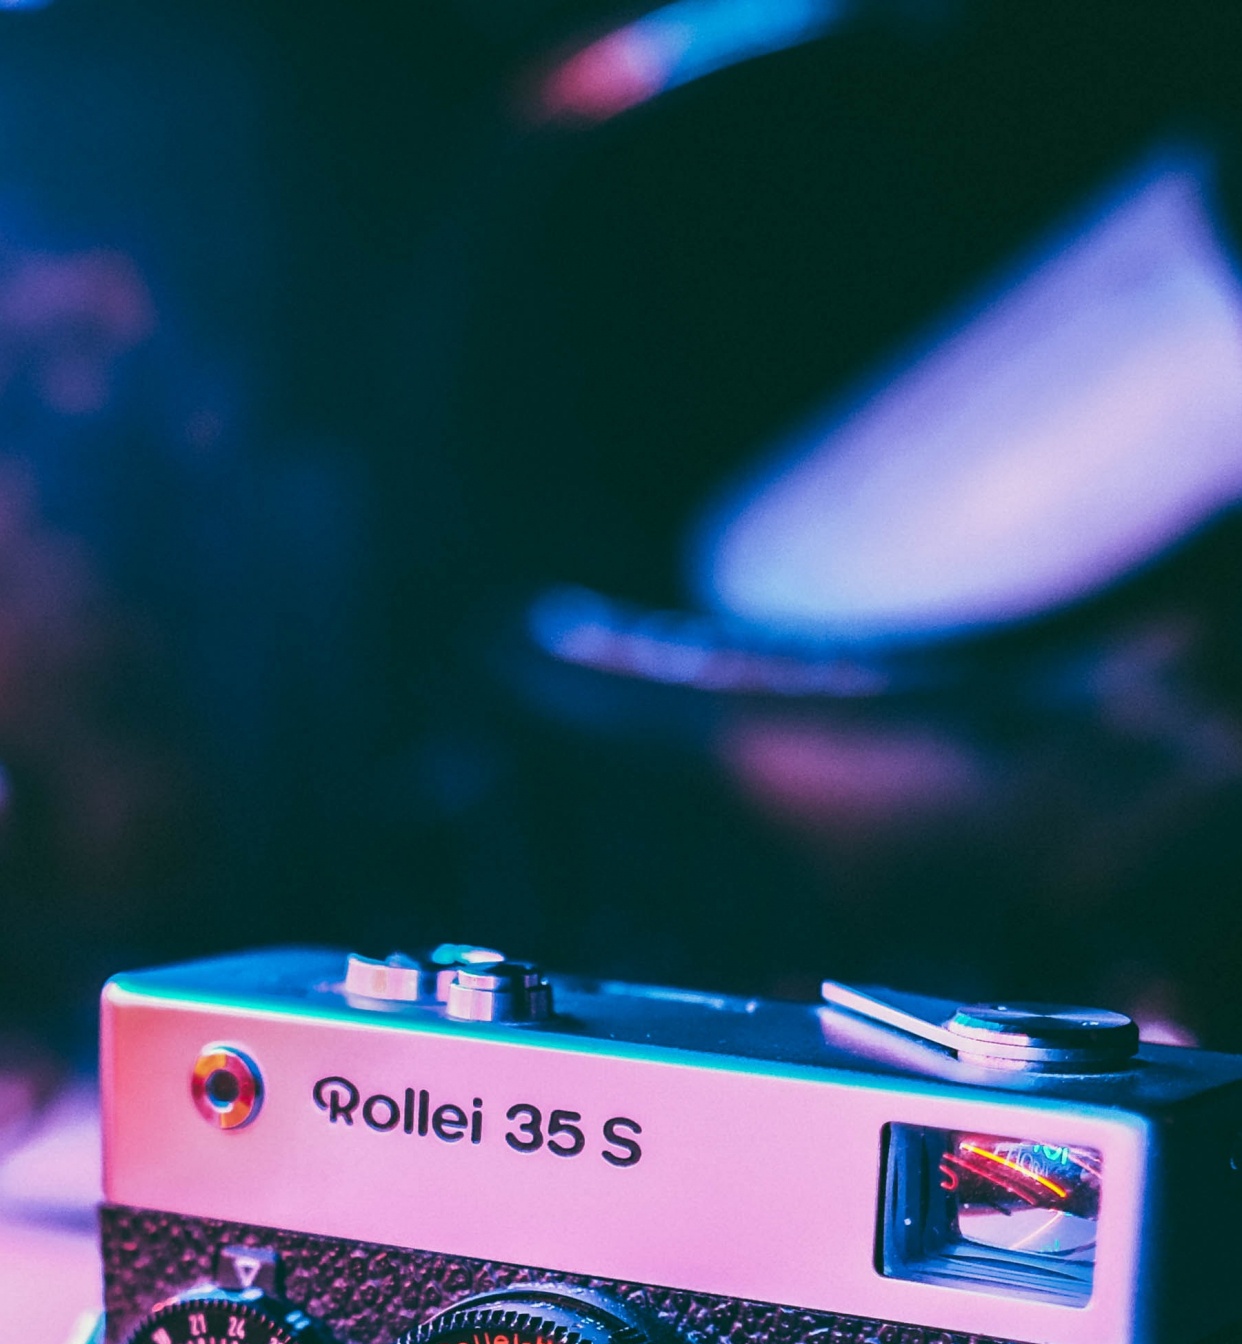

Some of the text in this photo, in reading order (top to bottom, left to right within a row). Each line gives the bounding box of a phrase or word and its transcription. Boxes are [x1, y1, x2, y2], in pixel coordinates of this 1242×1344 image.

[312, 1075, 642, 1167] Rollei 35 S
[189, 1313, 207, 1336] 21
[227, 1315, 246, 1340] 24
